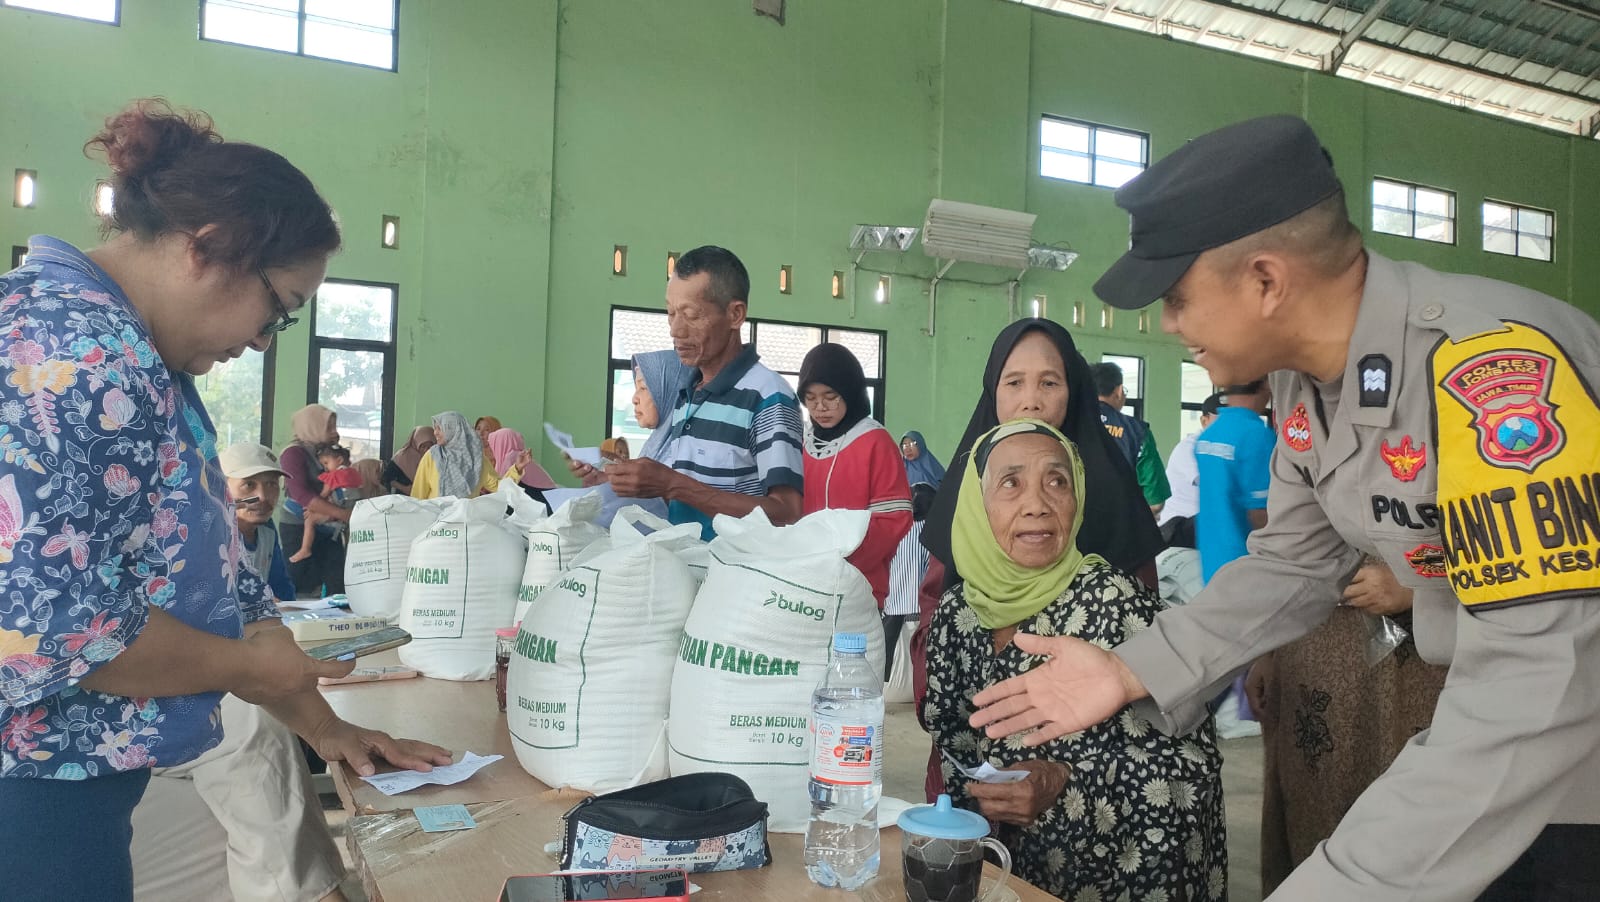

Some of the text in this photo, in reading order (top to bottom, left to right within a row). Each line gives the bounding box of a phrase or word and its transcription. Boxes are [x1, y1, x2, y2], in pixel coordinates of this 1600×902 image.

[1461, 359, 1538, 385] POLRES
[1461, 366, 1539, 389] JOMBANG
[1476, 383, 1537, 403] JAWA TIMUR
[1371, 494, 1439, 529] POLR
[778, 594, 826, 621] bulog
[709, 642, 801, 677] PANGAN
[518, 695, 567, 713] BERAS MEDIUM
[540, 718, 550, 729] 10
[552, 718, 566, 731] kg
[730, 714, 807, 729] BERAS MEDIUM
[771, 732, 785, 744] 10
[788, 732, 805, 747] kg
